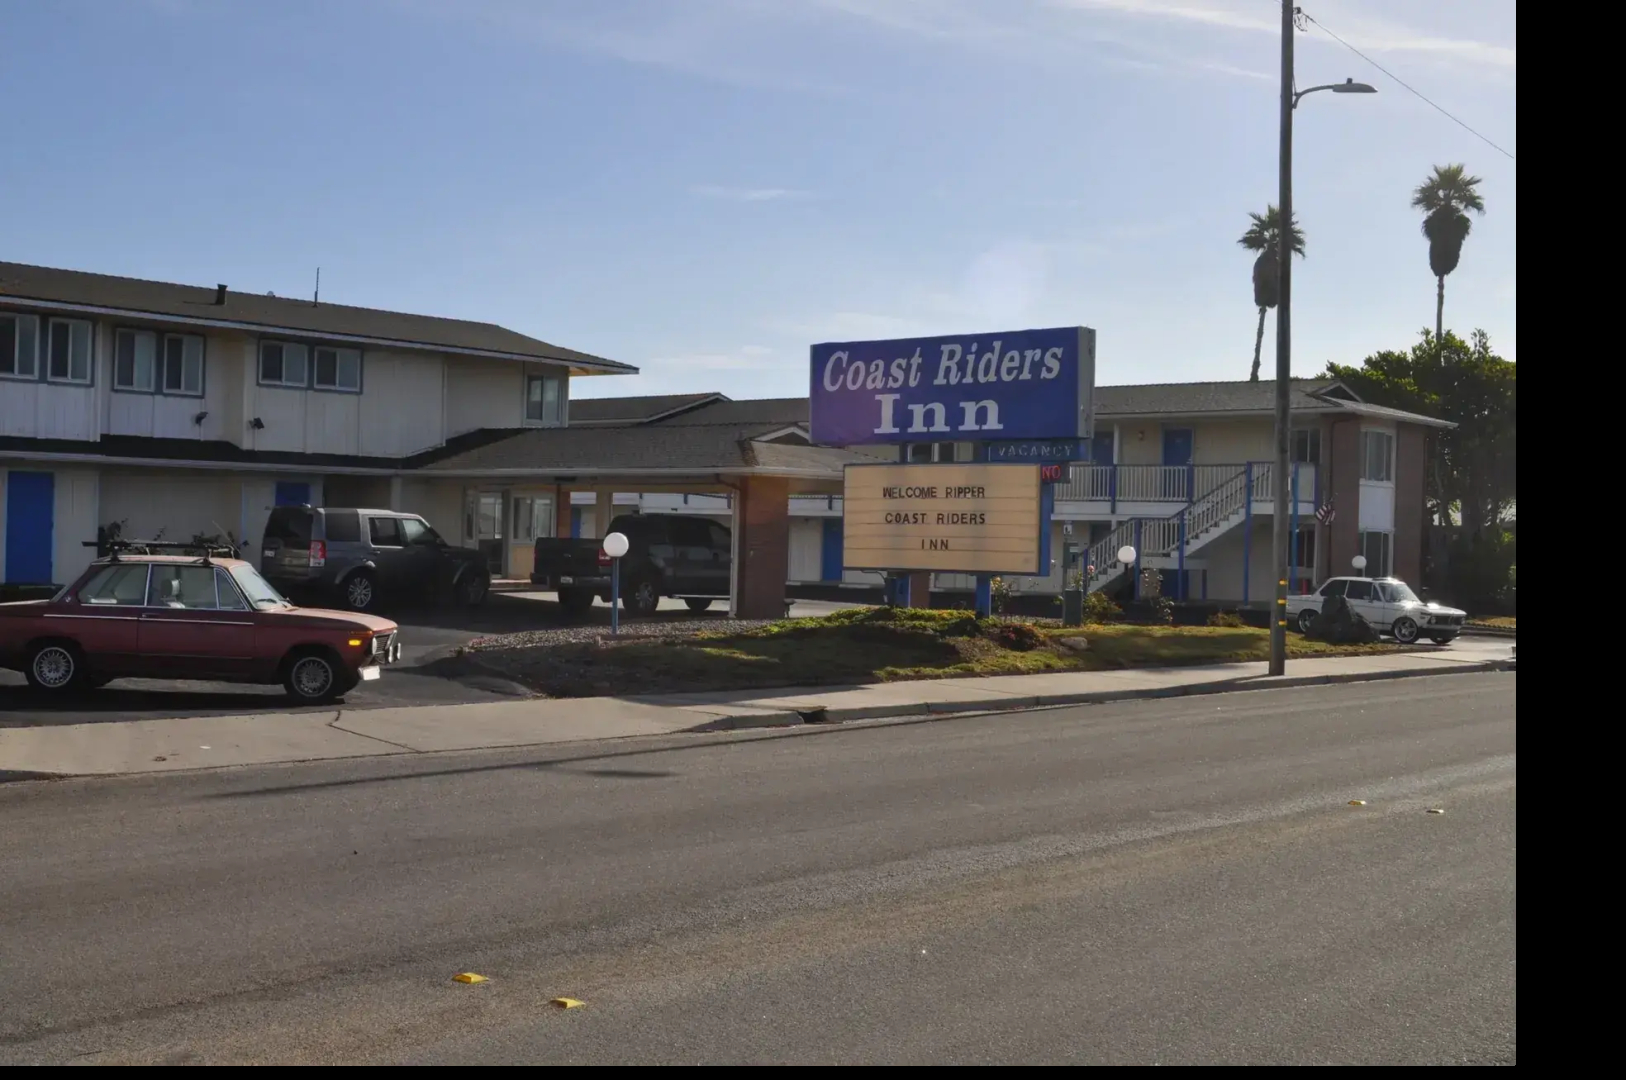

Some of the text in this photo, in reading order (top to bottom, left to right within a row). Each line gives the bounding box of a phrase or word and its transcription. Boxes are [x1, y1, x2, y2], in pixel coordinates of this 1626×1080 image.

[823, 341, 1064, 391] Coast Riders
[873, 393, 1004, 434] Inn
[998, 444, 1074, 457] VACANCY
[1042, 465, 1061, 479] NO
[883, 486, 985, 498] WELCOME RIPPER
[885, 512, 986, 525] COAST RIDERS
[921, 539, 949, 550] INN
